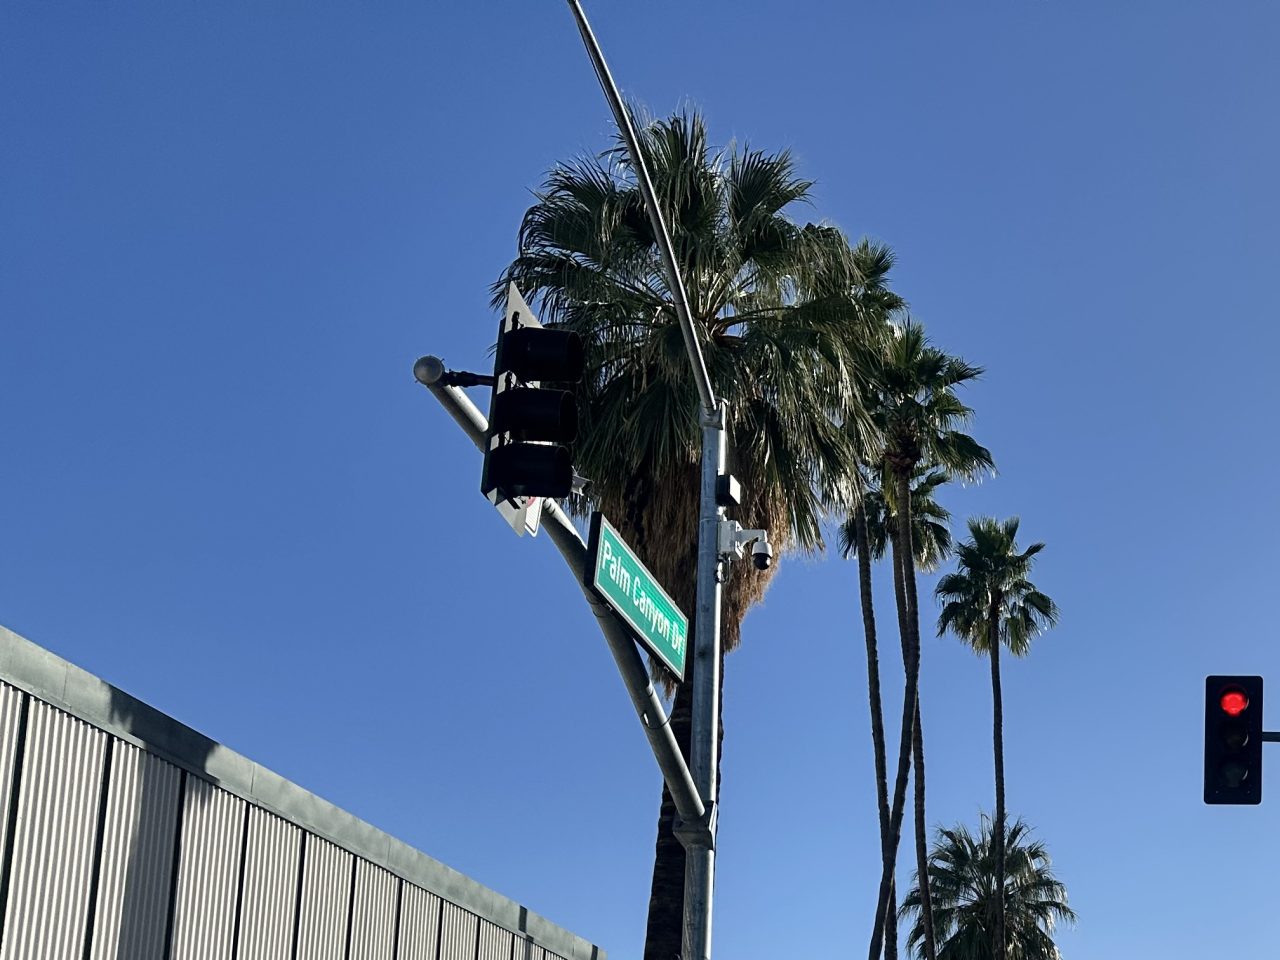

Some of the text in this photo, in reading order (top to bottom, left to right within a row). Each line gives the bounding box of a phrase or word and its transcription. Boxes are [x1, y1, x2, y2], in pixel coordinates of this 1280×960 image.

[602, 540, 684, 655] Palm Canyon Dr
